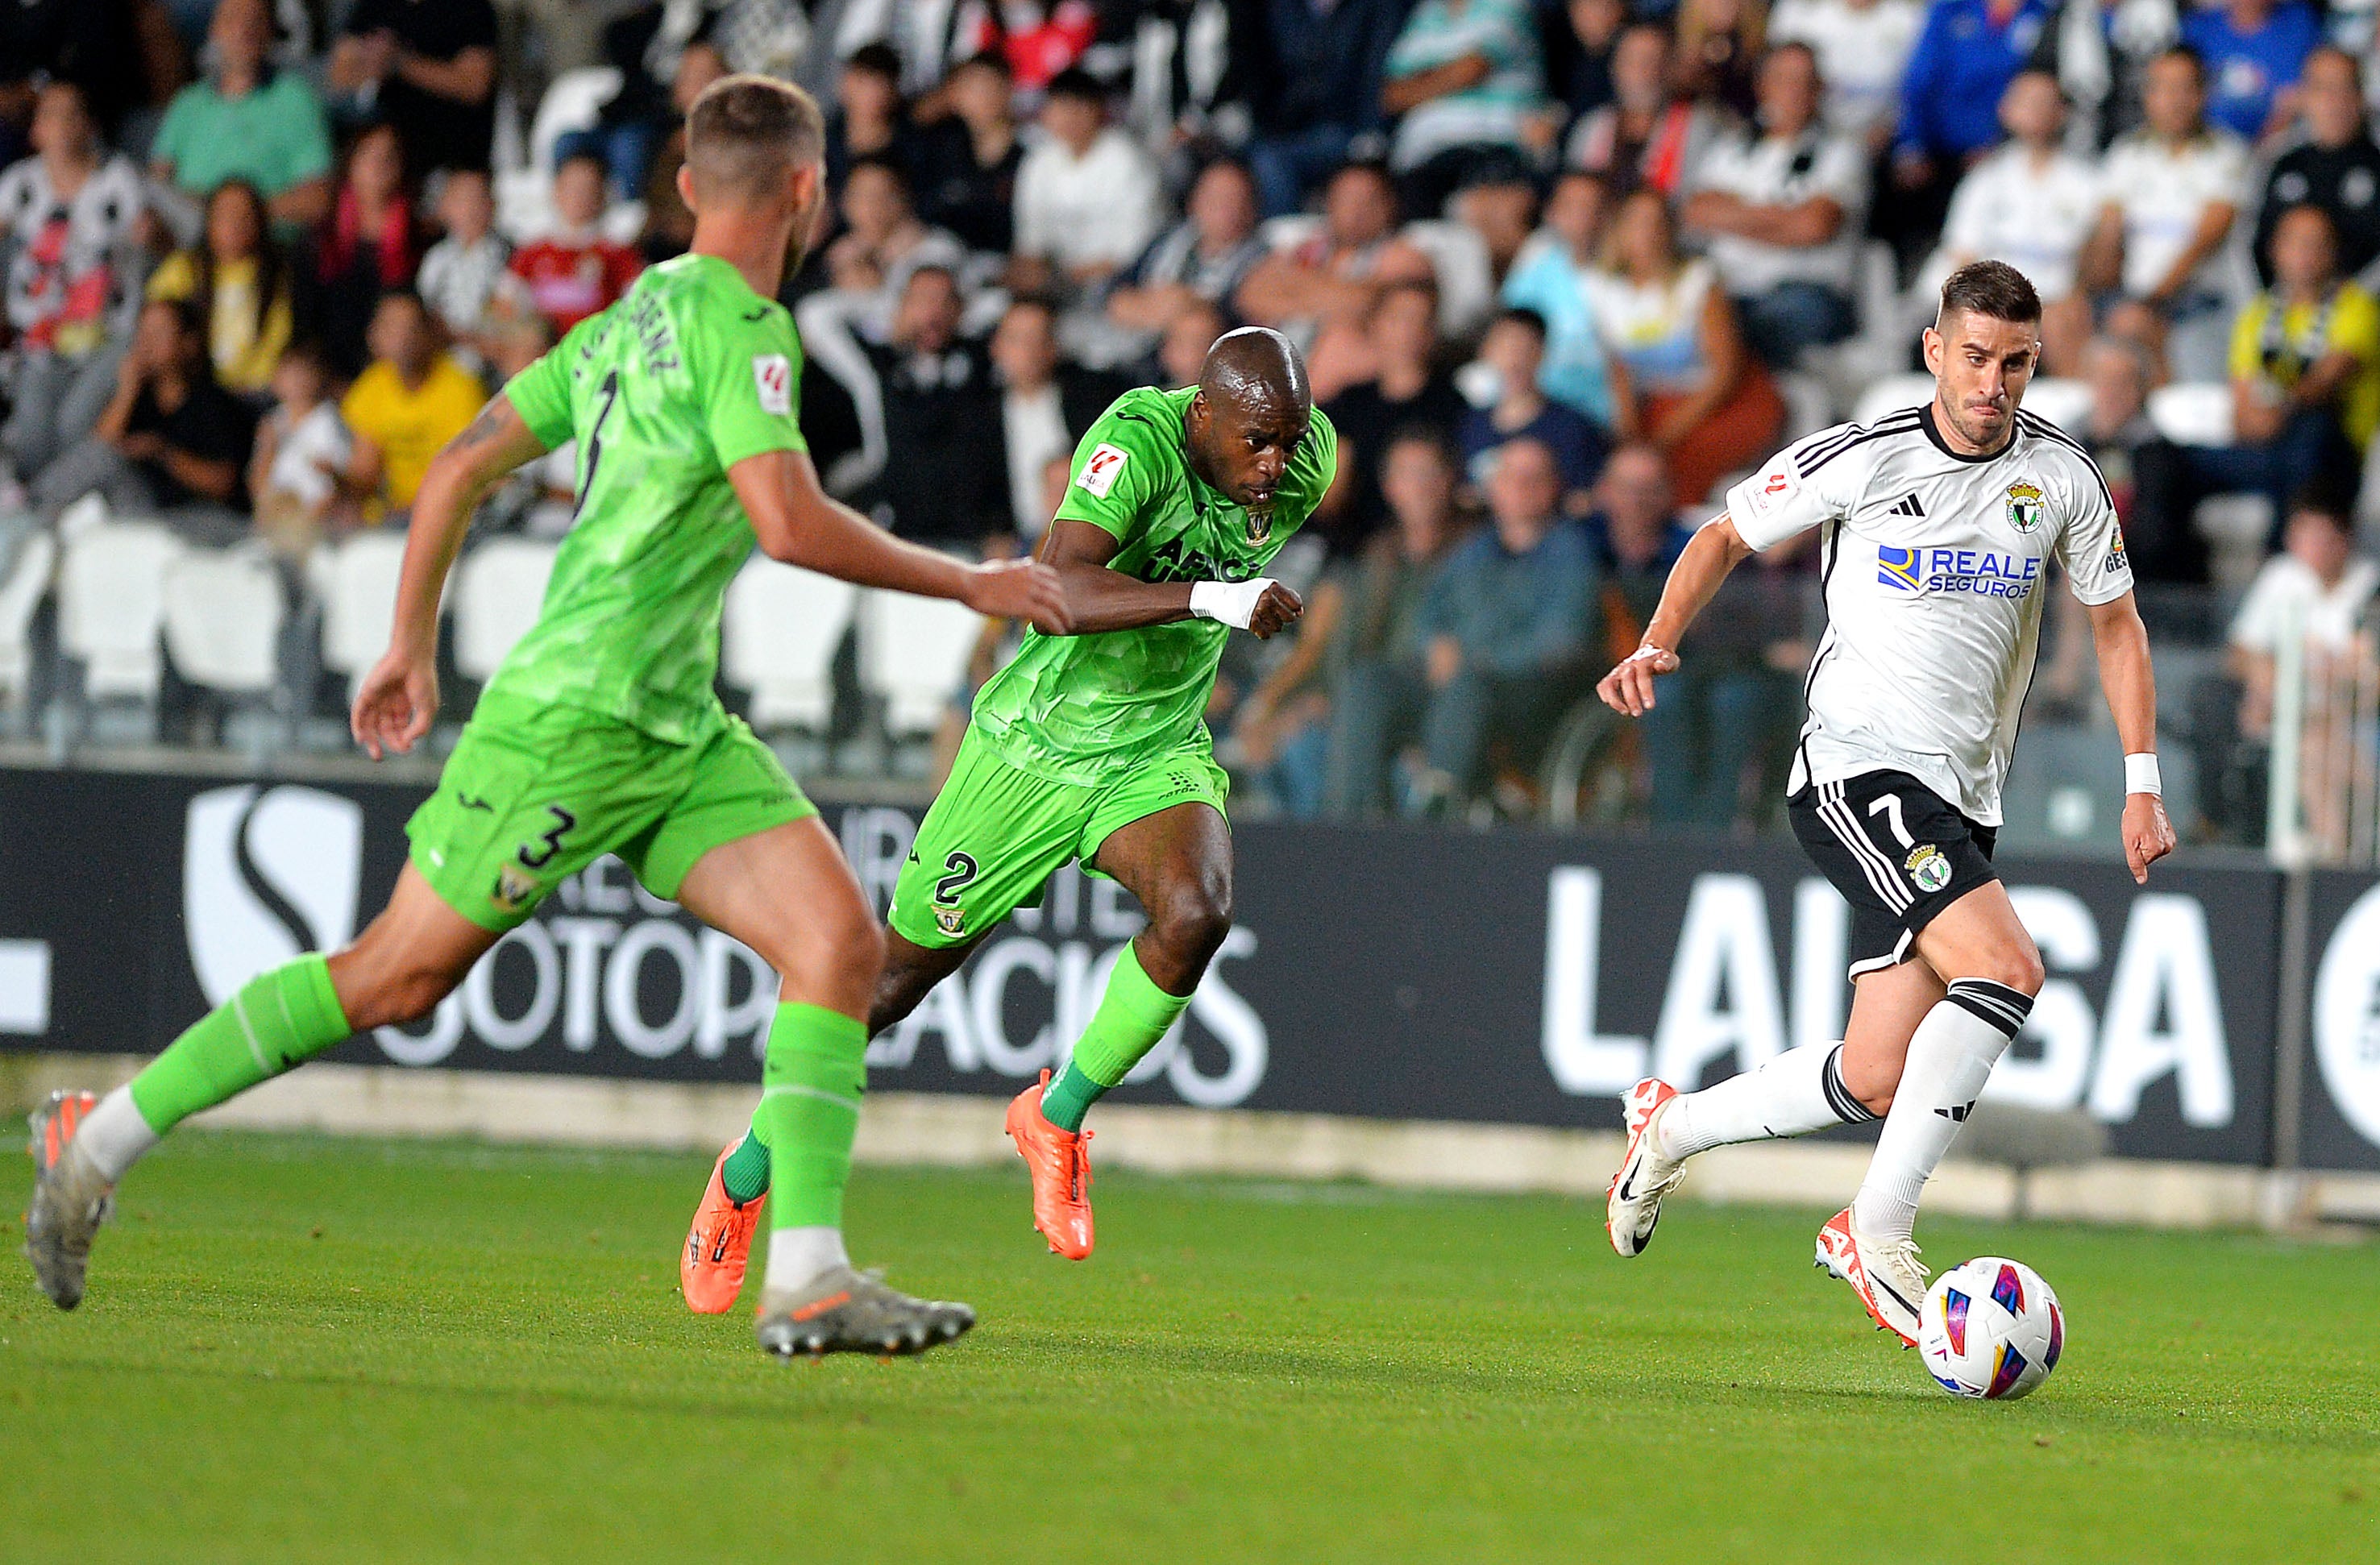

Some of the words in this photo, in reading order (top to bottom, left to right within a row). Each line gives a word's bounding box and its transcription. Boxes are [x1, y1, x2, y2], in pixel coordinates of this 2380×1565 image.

[1928, 575, 2031, 599] SEGUROS
[1932, 550, 2041, 580] REALE
[517, 806, 576, 870] 3
[1868, 792, 1915, 850] 7
[935, 851, 978, 906] 2
[1541, 864, 2235, 1128] LALGA
